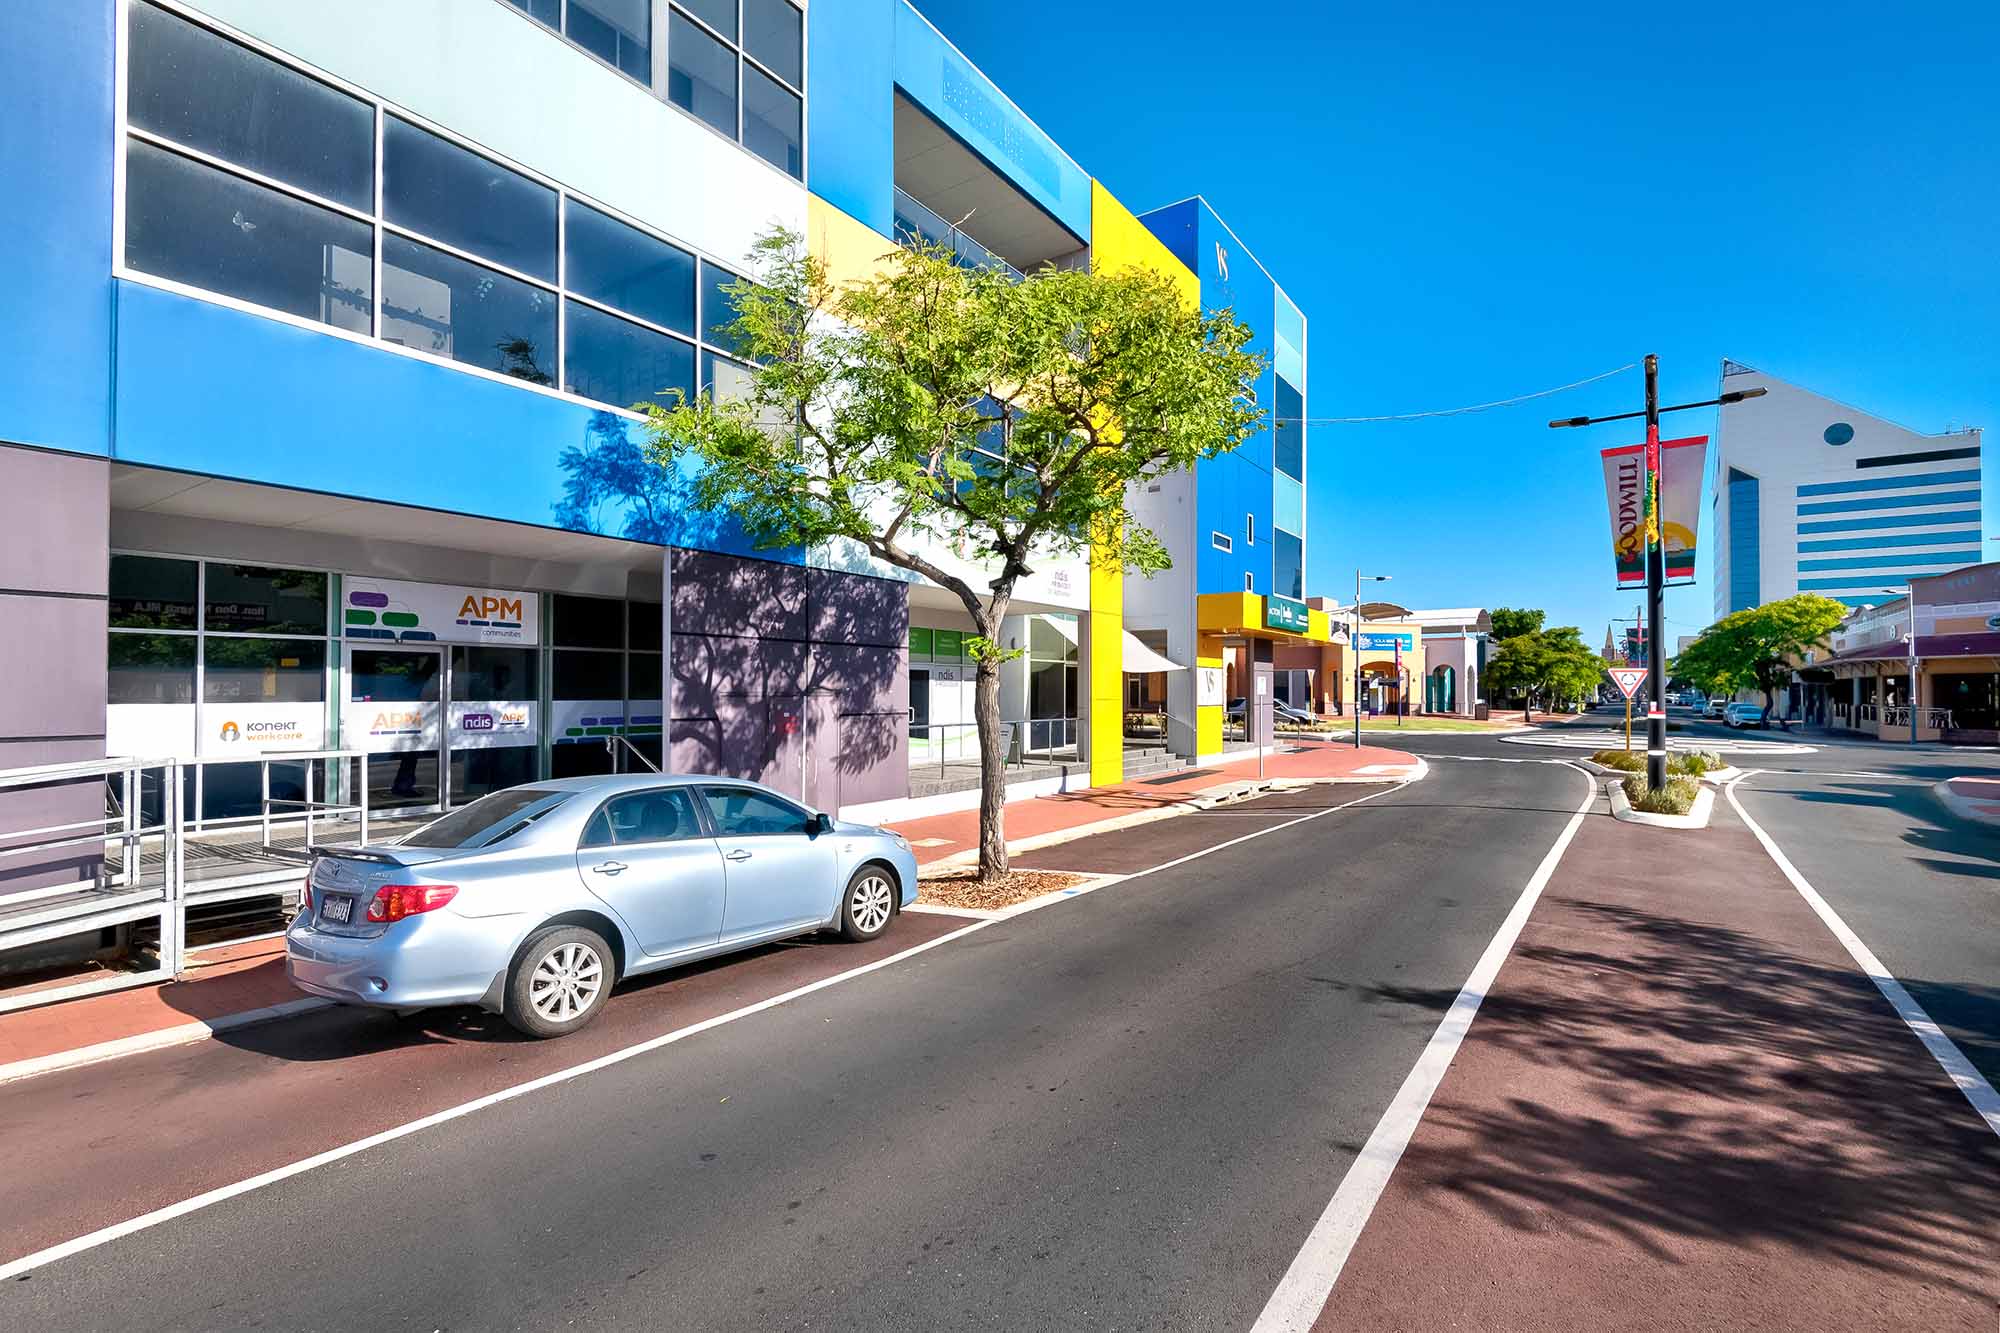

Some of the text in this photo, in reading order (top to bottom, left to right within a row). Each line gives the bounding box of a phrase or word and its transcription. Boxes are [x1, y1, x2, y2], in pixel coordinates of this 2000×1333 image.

[458, 595, 522, 621] APM
[372, 711, 422, 729] APM
[464, 714, 492, 728] ndis
[247, 732, 303, 741] workcare
